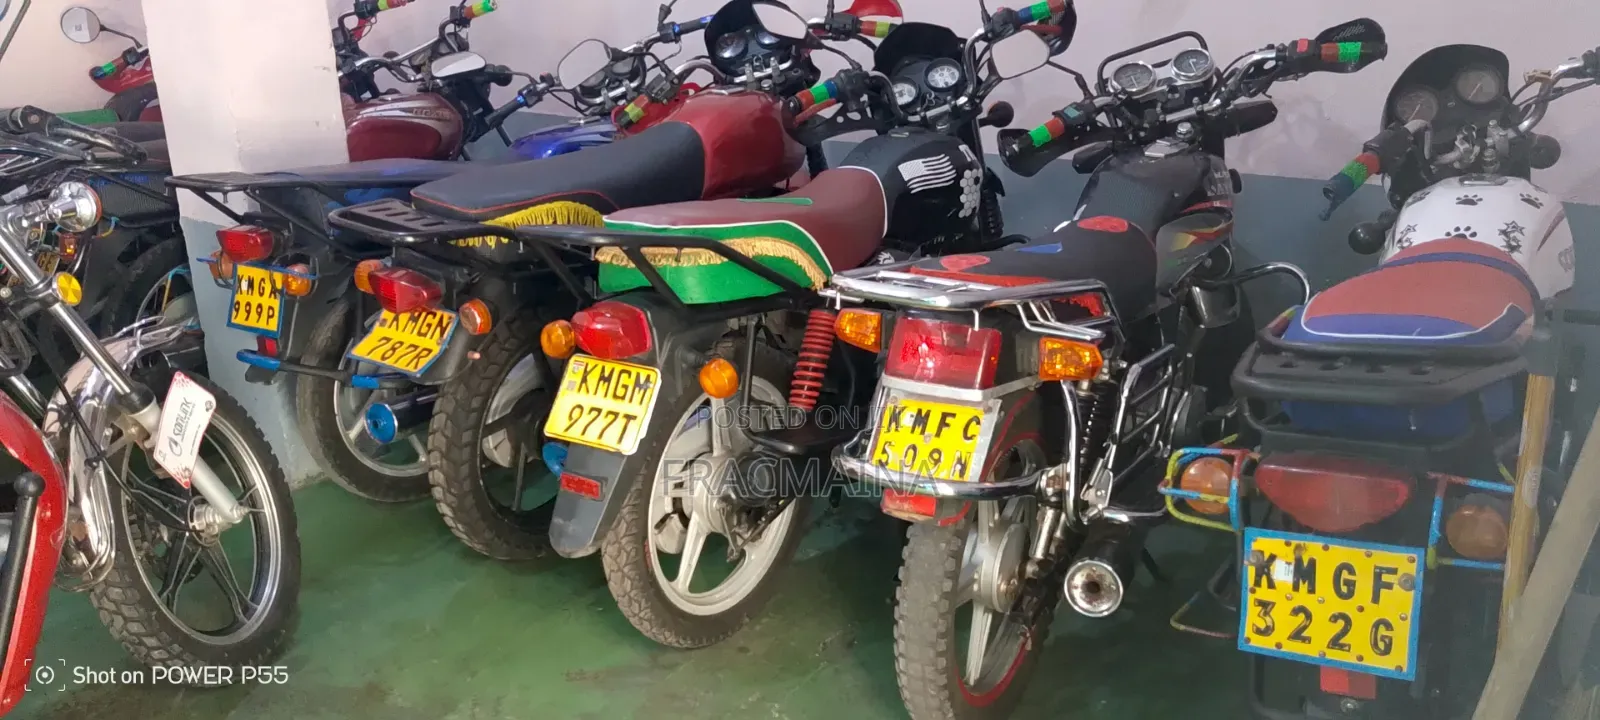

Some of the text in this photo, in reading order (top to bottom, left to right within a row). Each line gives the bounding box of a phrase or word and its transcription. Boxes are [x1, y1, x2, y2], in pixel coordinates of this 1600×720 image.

[236, 270, 280, 299] KMGA
[234, 300, 275, 325] 999P
[387, 309, 454, 340] KMGN
[366, 336, 433, 370] 787R
[577, 362, 653, 405] KMGM
[563, 404, 638, 444] 977T
[884, 404, 981, 441] KMFC
[881, 440, 973, 479] 509N
[1252, 550, 1398, 605] KMGF
[1251, 598, 1395, 657] 322G
